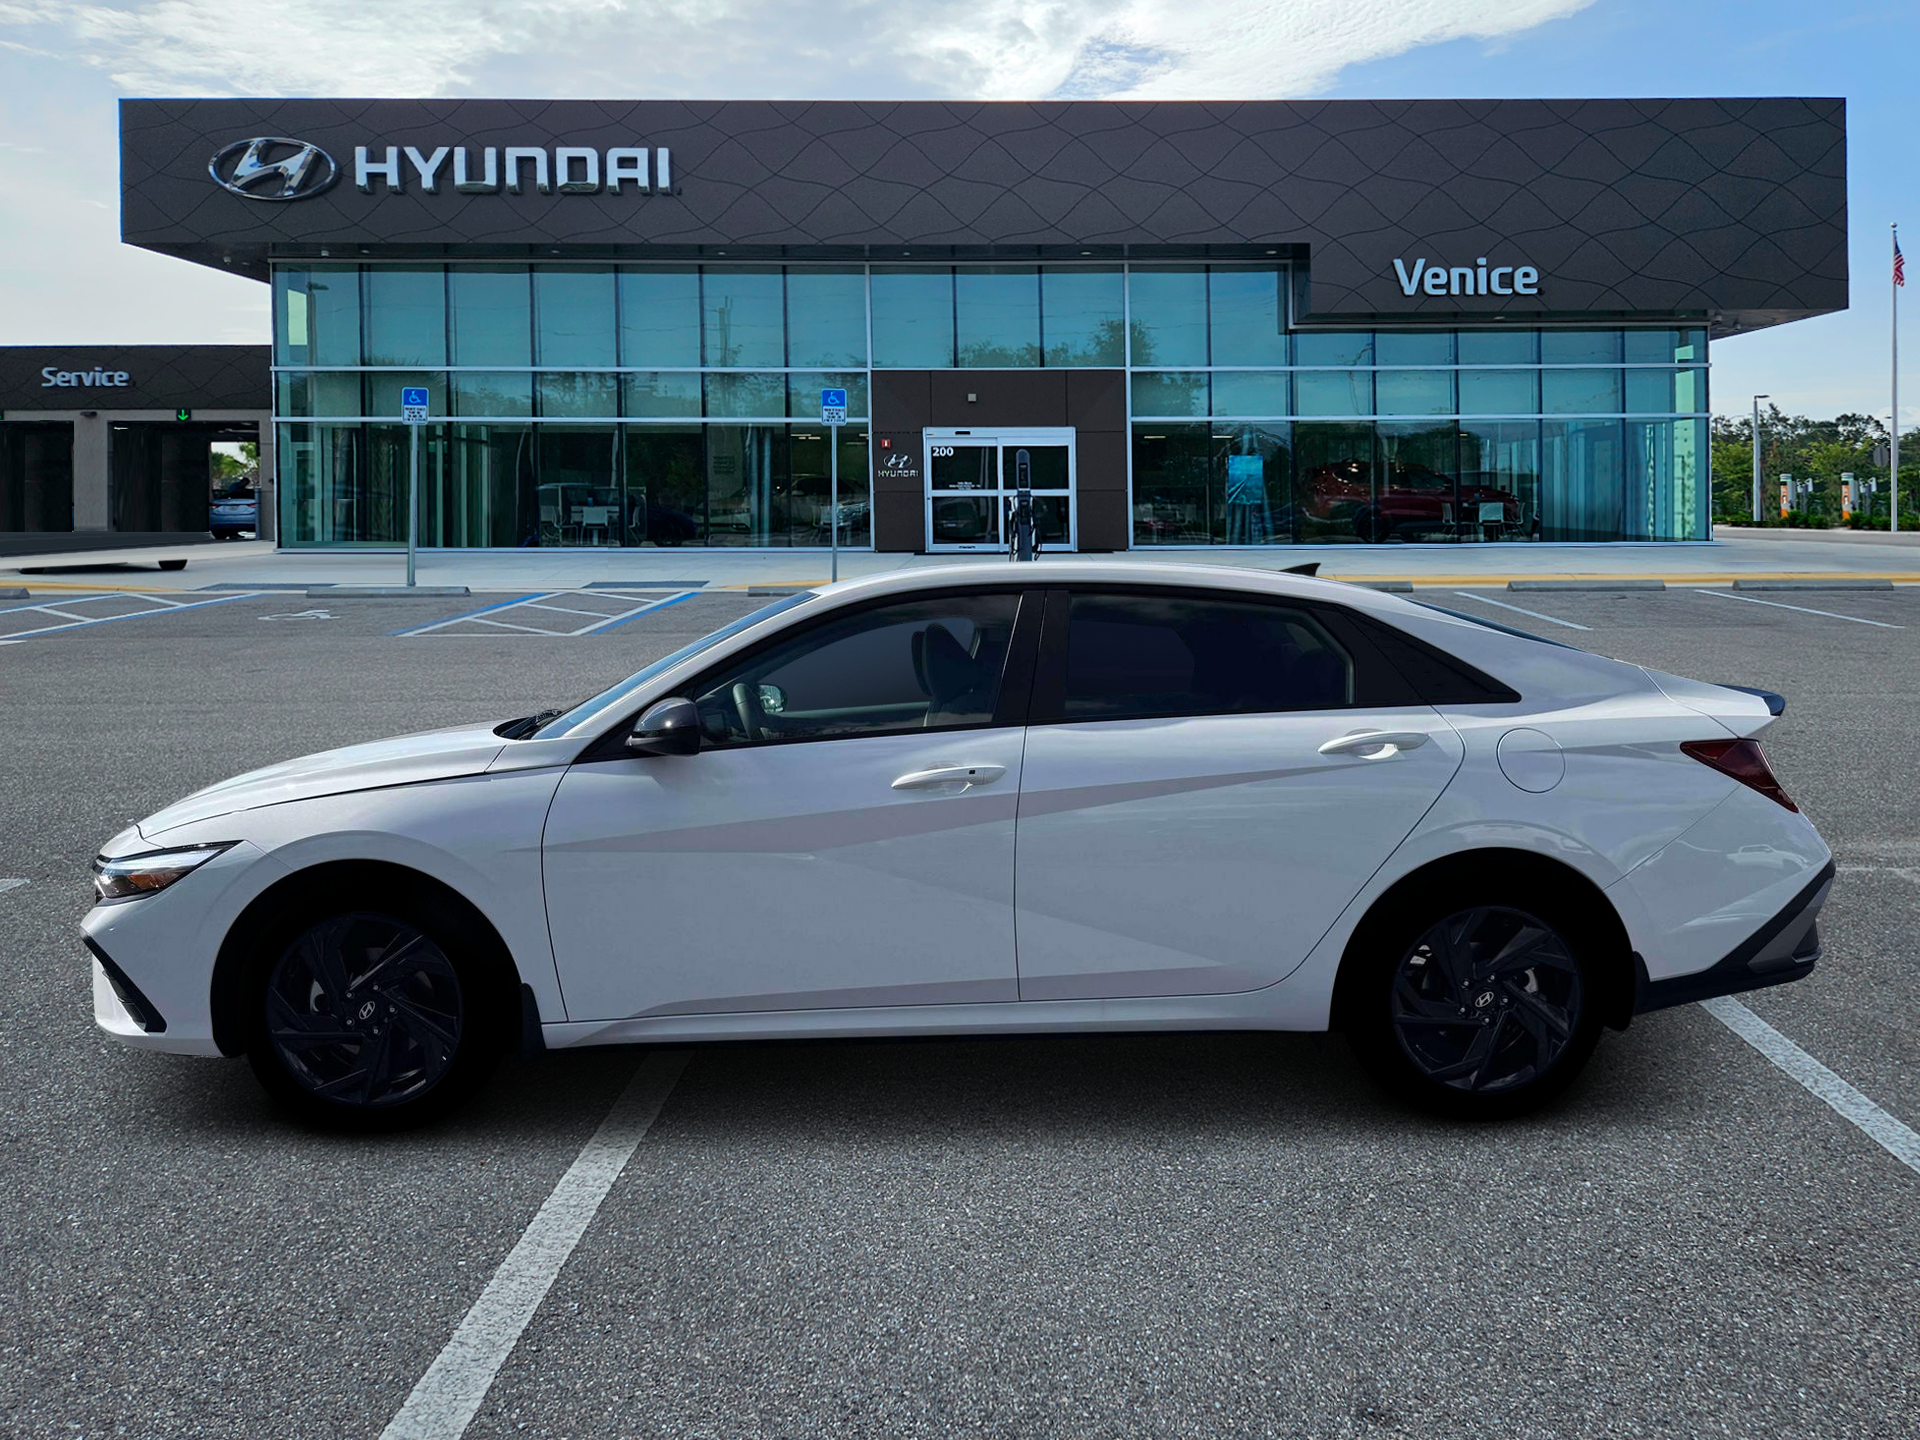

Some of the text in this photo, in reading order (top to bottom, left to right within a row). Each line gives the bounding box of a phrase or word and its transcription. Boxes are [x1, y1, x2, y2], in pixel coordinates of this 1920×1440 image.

[355, 146, 672, 194] HYUNDAI
[1393, 257, 1539, 296] Venice
[41, 366, 130, 387] Service
[932, 446, 954, 457] 200
[877, 469, 920, 478] HYUNDAI
